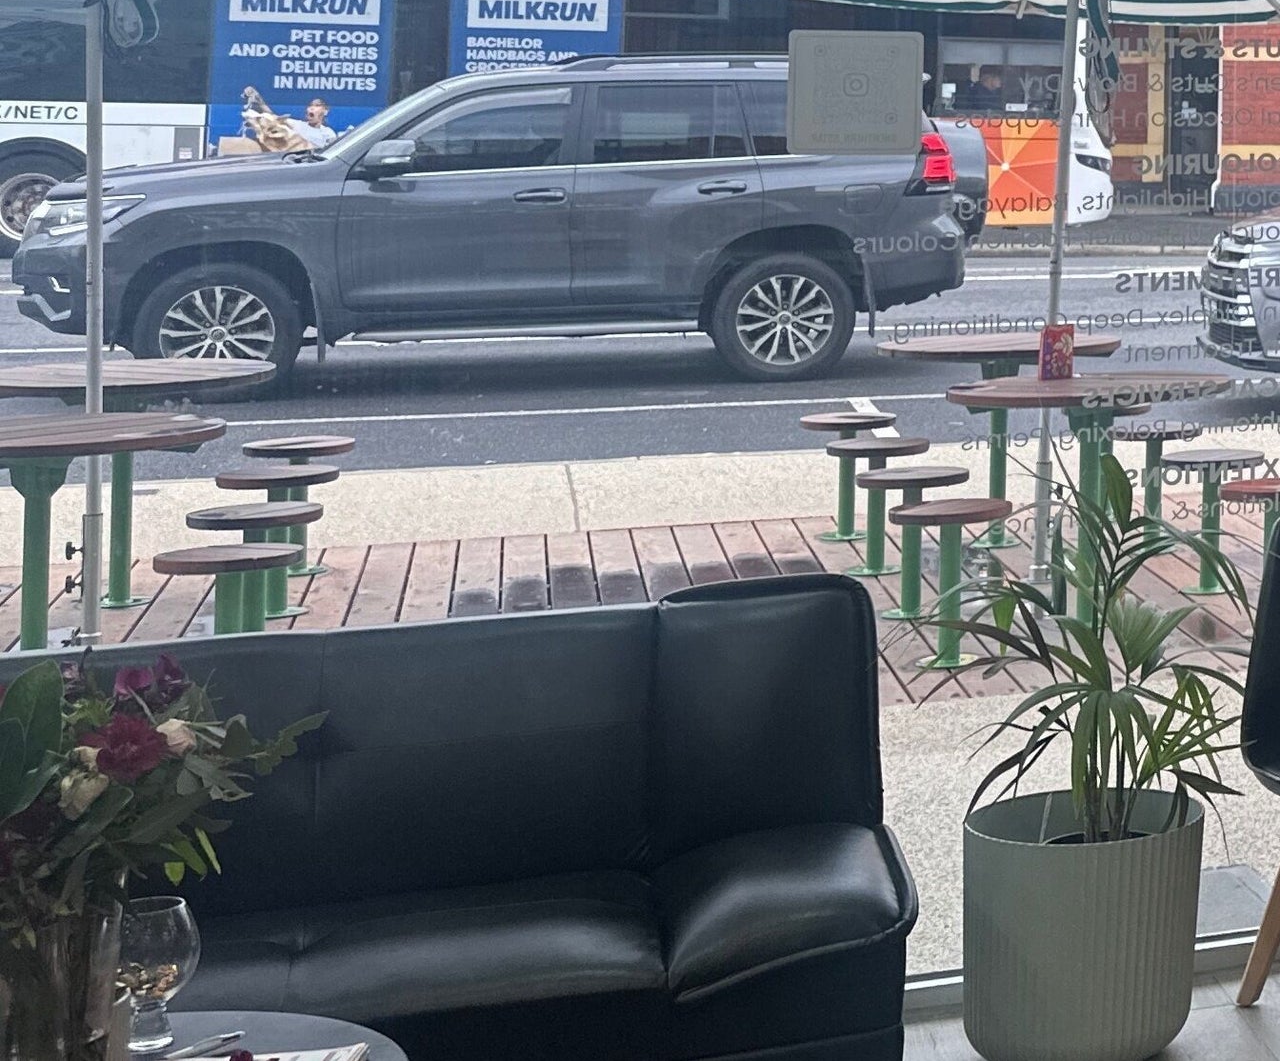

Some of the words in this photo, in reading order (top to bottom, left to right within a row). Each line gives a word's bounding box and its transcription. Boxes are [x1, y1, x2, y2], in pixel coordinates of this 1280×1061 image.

[478, 0, 598, 22] MILKRUN
[290, 29, 324, 43] PET
[327, 31, 379, 45] FOOD
[467, 37, 543, 49] BACHELOR
[229, 43, 270, 57] AND
[272, 45, 378, 60] GROCERIES
[466, 50, 546, 62] HANDBAGS
[281, 60, 377, 75] DELIVERED
[274, 76, 293, 89] IN
[297, 76, 377, 91] MINUTES
[0, 105, 78, 121] /NET/C
